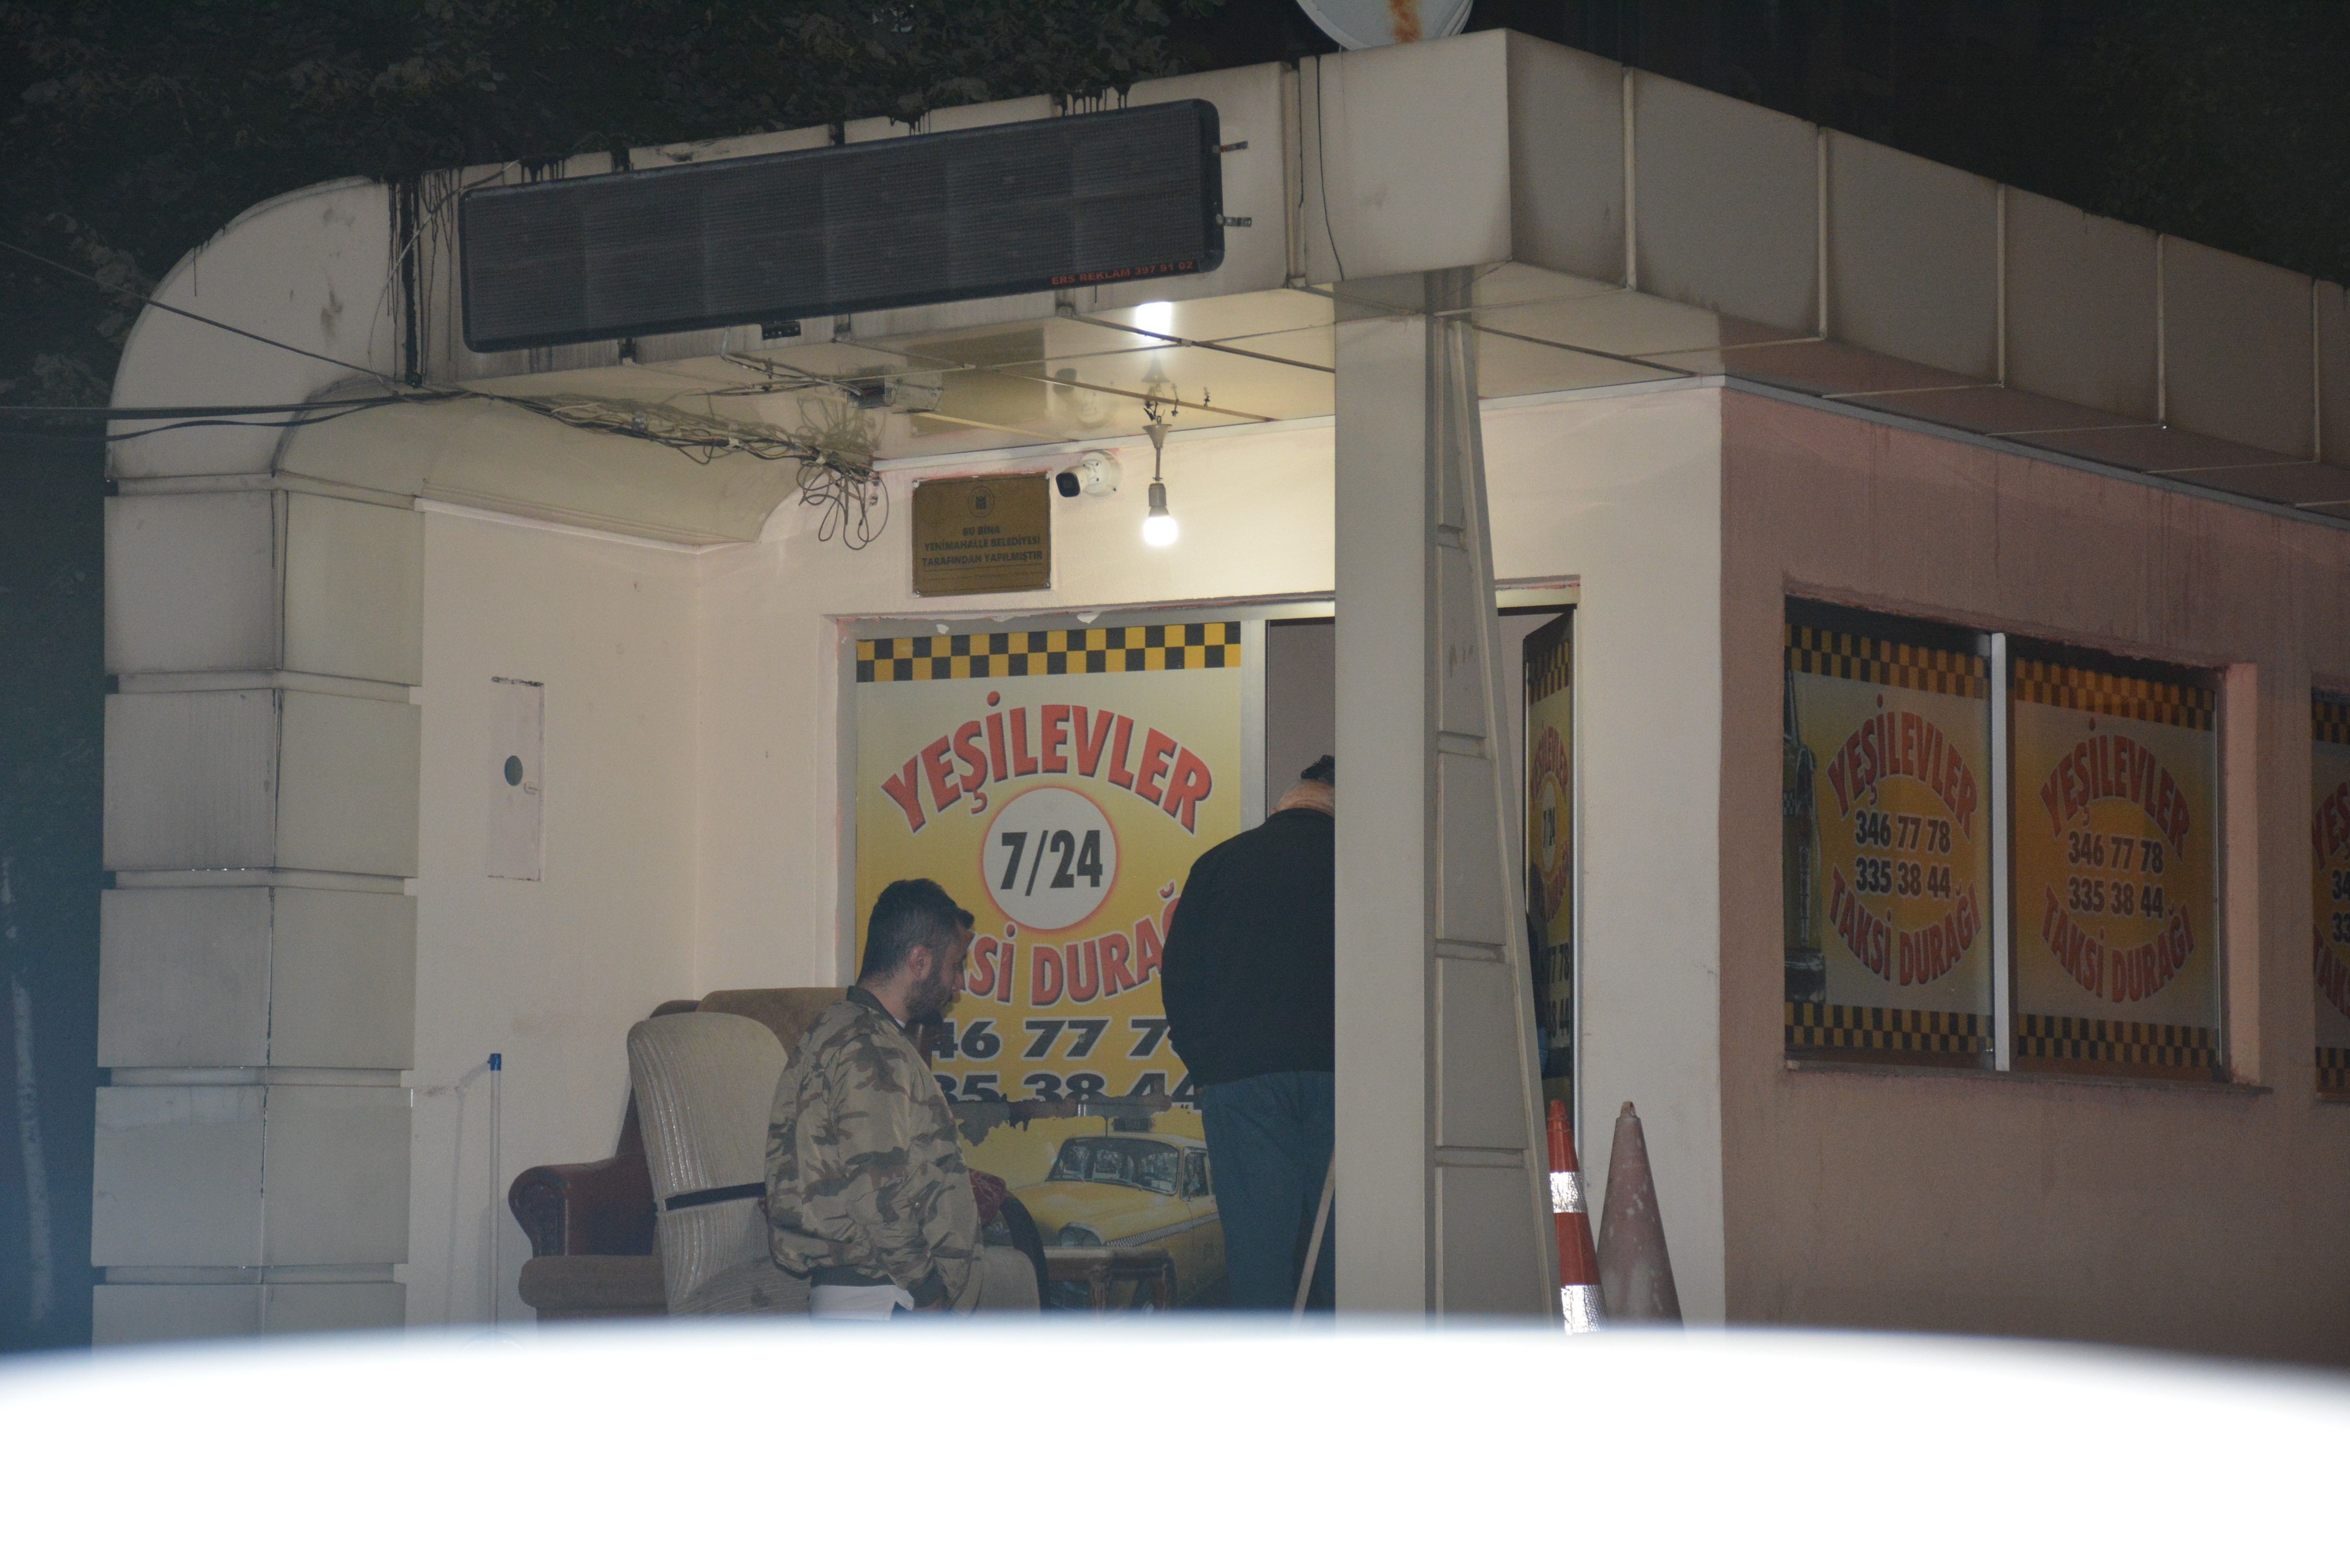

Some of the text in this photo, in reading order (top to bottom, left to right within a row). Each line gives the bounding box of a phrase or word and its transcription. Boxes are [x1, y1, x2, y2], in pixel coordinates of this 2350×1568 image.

[1052, 275, 1075, 285] ERS
[1079, 269, 1131, 282] REKLAM
[1134, 264, 1156, 275] 397
[1178, 261, 1194, 270] 02
[962, 526, 975, 536] BU
[881, 691, 1212, 835] YEŞİLEVLER
[1828, 694, 1978, 839] YEŞİLEVLER
[2041, 718, 2190, 862] YEŞİLEVLER
[1856, 811, 1951, 854] 346 77 78
[2069, 832, 2164, 874] 346 77 78
[1000, 829, 1103, 896] 7/24
[1856, 858, 1951, 899] 335 38 44
[2069, 878, 2164, 919] 335 38 44
[1032, 881, 1181, 1006] DURA
[1830, 867, 1982, 986] TAKSİ DURAĞI
[2042, 884, 2195, 1004] TAKSİ DURAĞI
[931, 1019, 1171, 1058] 46 77 7
